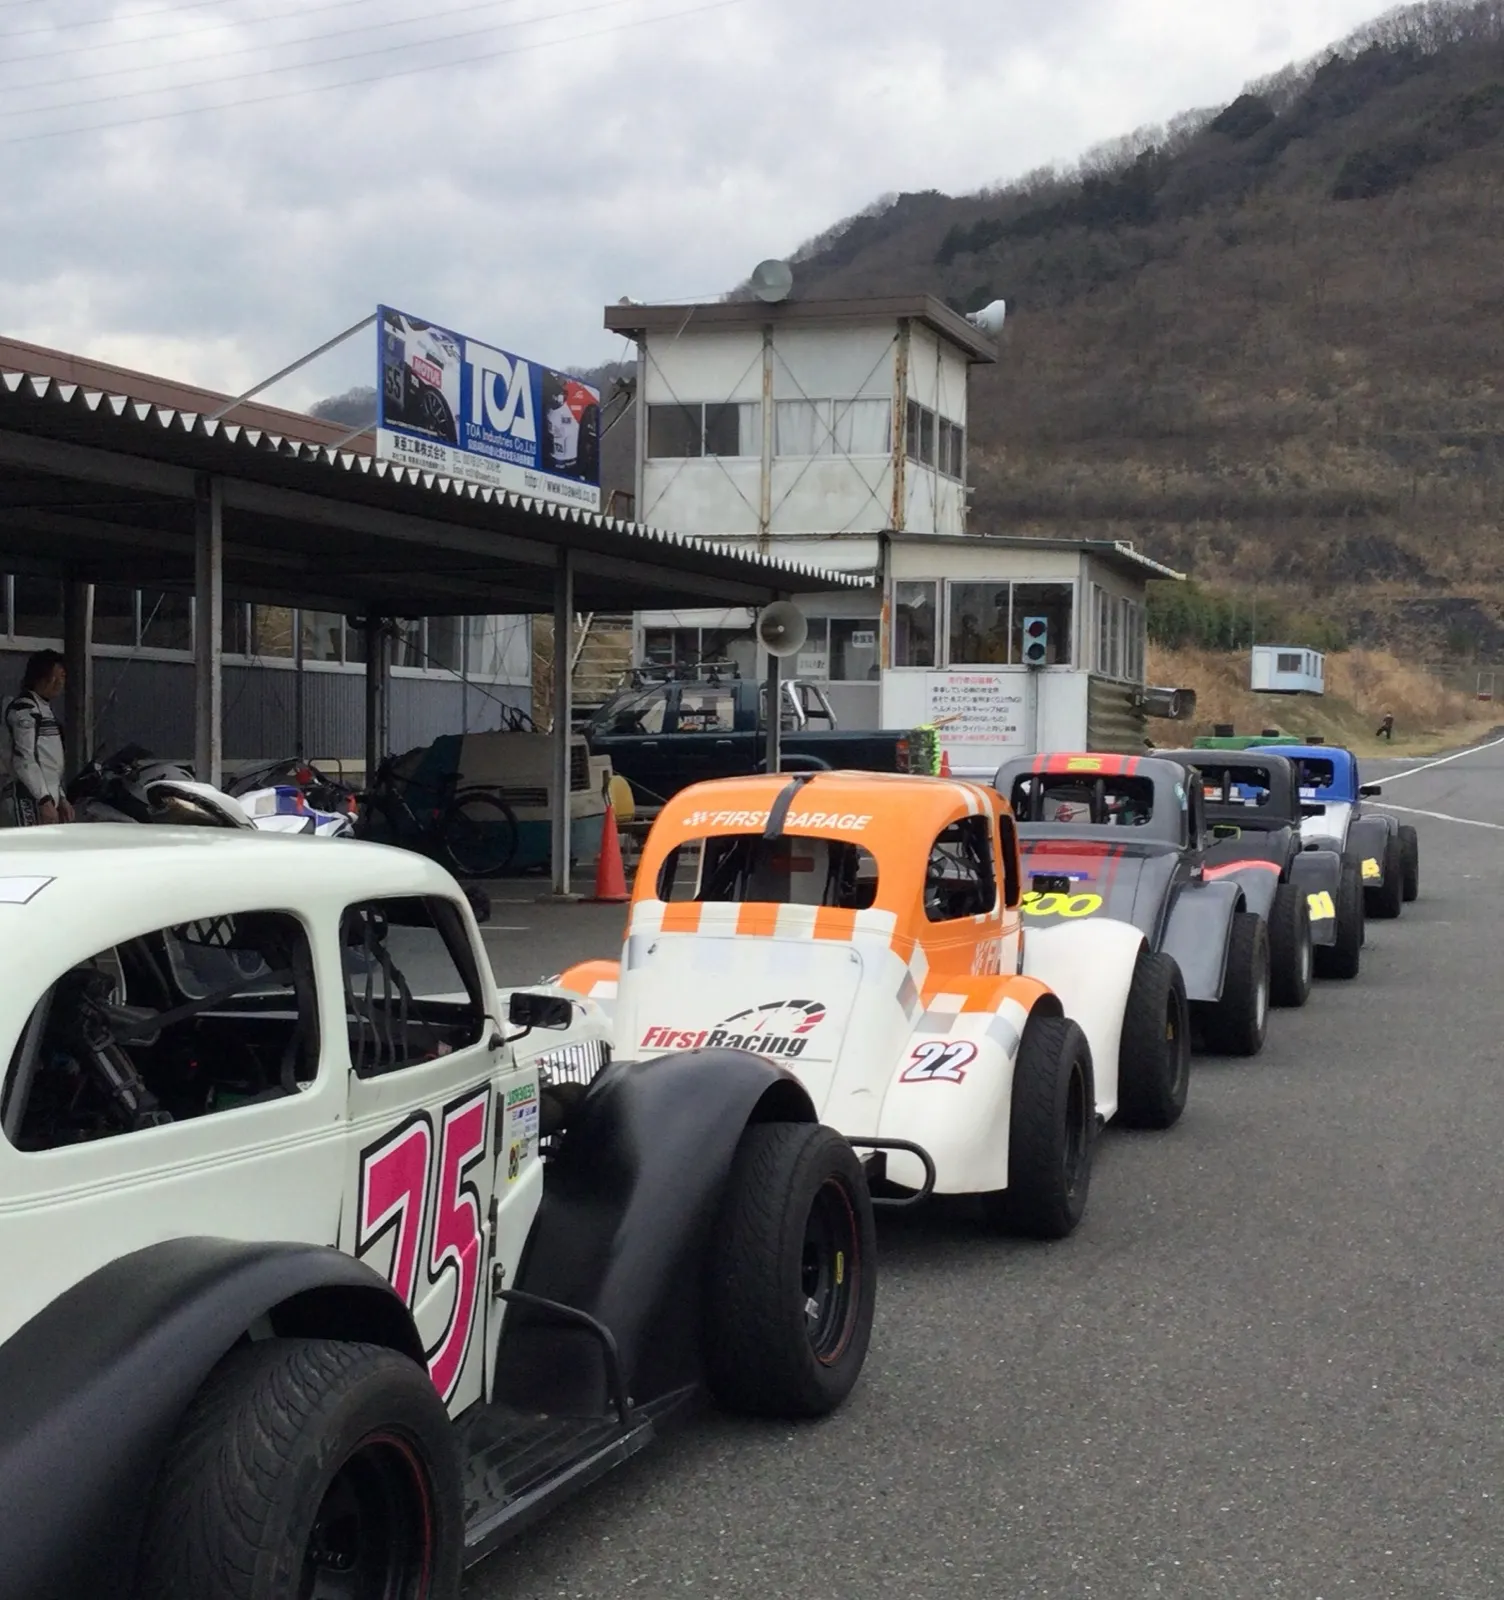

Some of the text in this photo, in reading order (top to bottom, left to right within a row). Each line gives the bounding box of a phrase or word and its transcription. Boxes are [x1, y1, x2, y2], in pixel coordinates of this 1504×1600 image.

[465, 340, 537, 442] TOA
[465, 422, 481, 438] TOA
[710, 811, 873, 831] FIRST GARAGE
[898, 1039, 978, 1085] 22
[354, 1081, 493, 1408] 75
